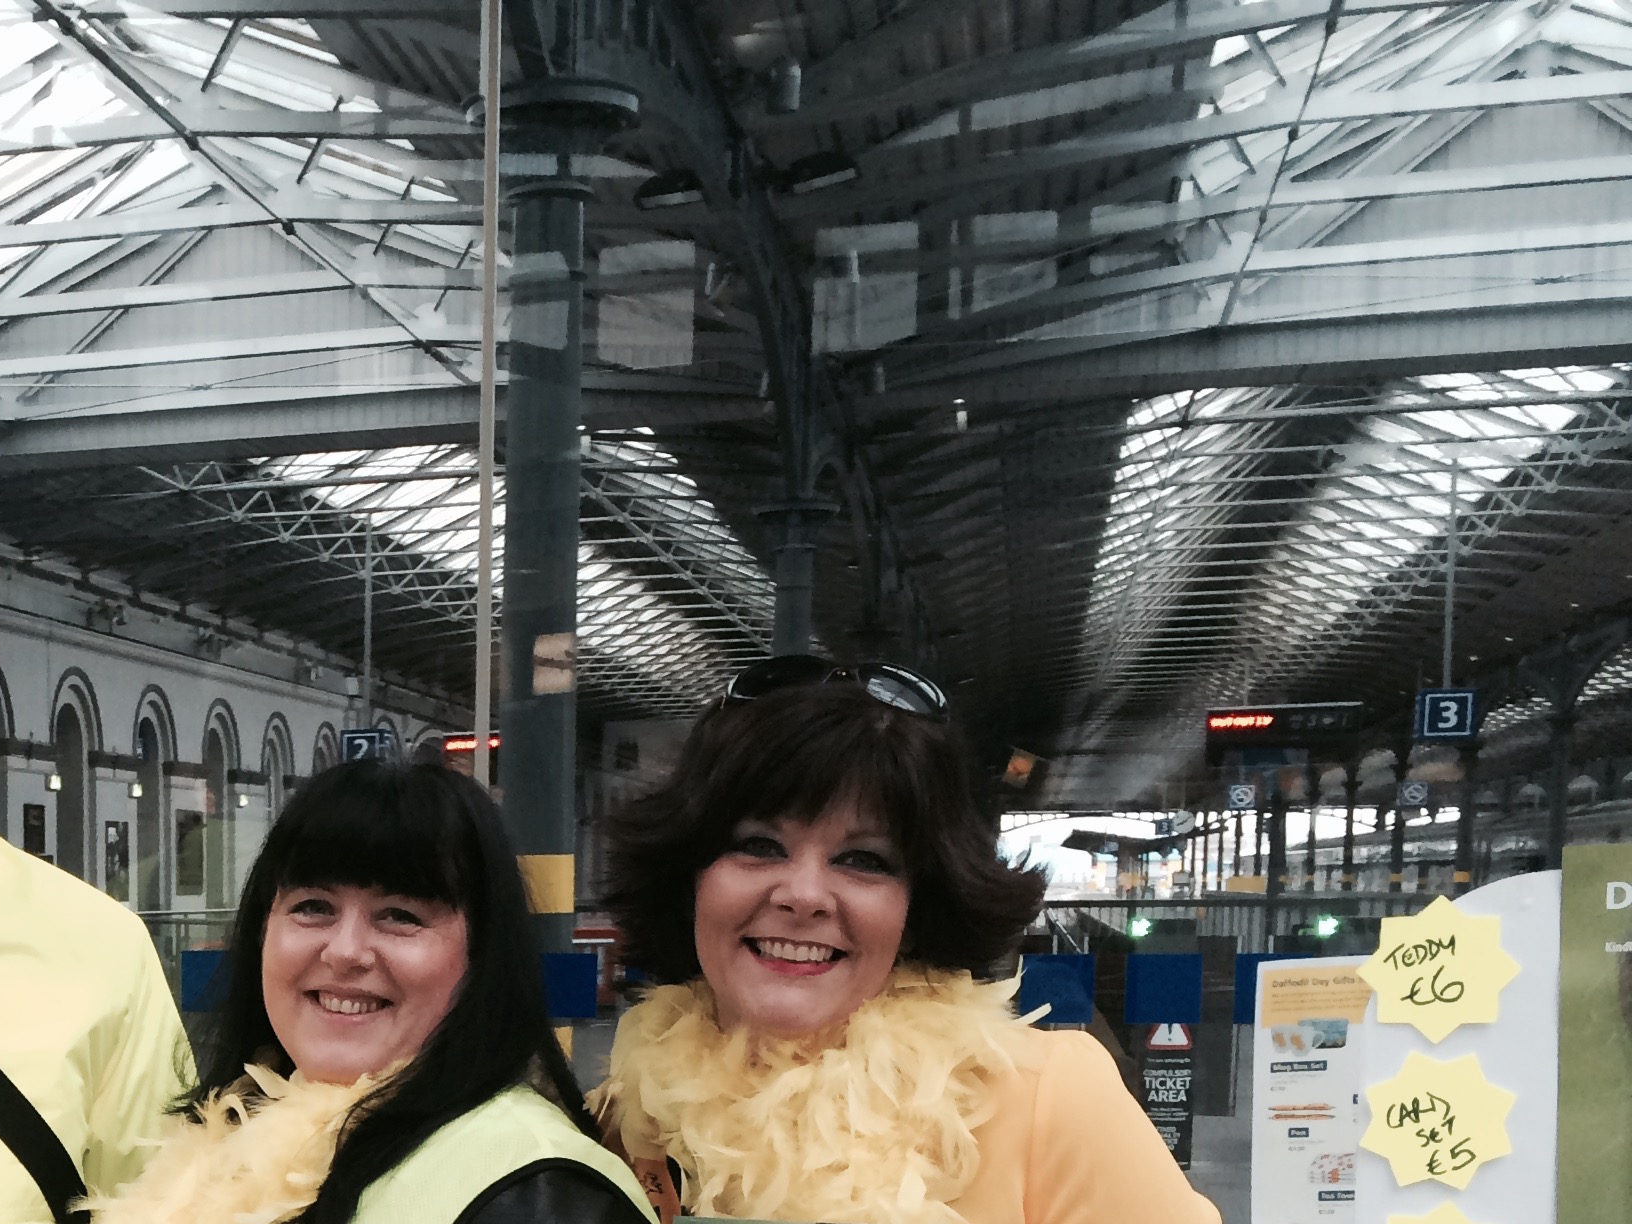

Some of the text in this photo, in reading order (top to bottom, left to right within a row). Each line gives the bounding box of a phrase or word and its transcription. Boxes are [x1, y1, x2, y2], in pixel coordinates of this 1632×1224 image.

[1436, 700, 1460, 729] 3
[352, 738, 369, 760] 2
[1383, 934, 1456, 970] TEDDY
[1400, 965, 1465, 1006] €6
[1144, 1076, 1192, 1091] TICKET
[1148, 1089, 1187, 1103] AREA
[1386, 1091, 1452, 1129] CARD
[1426, 1137, 1477, 1176] €5
